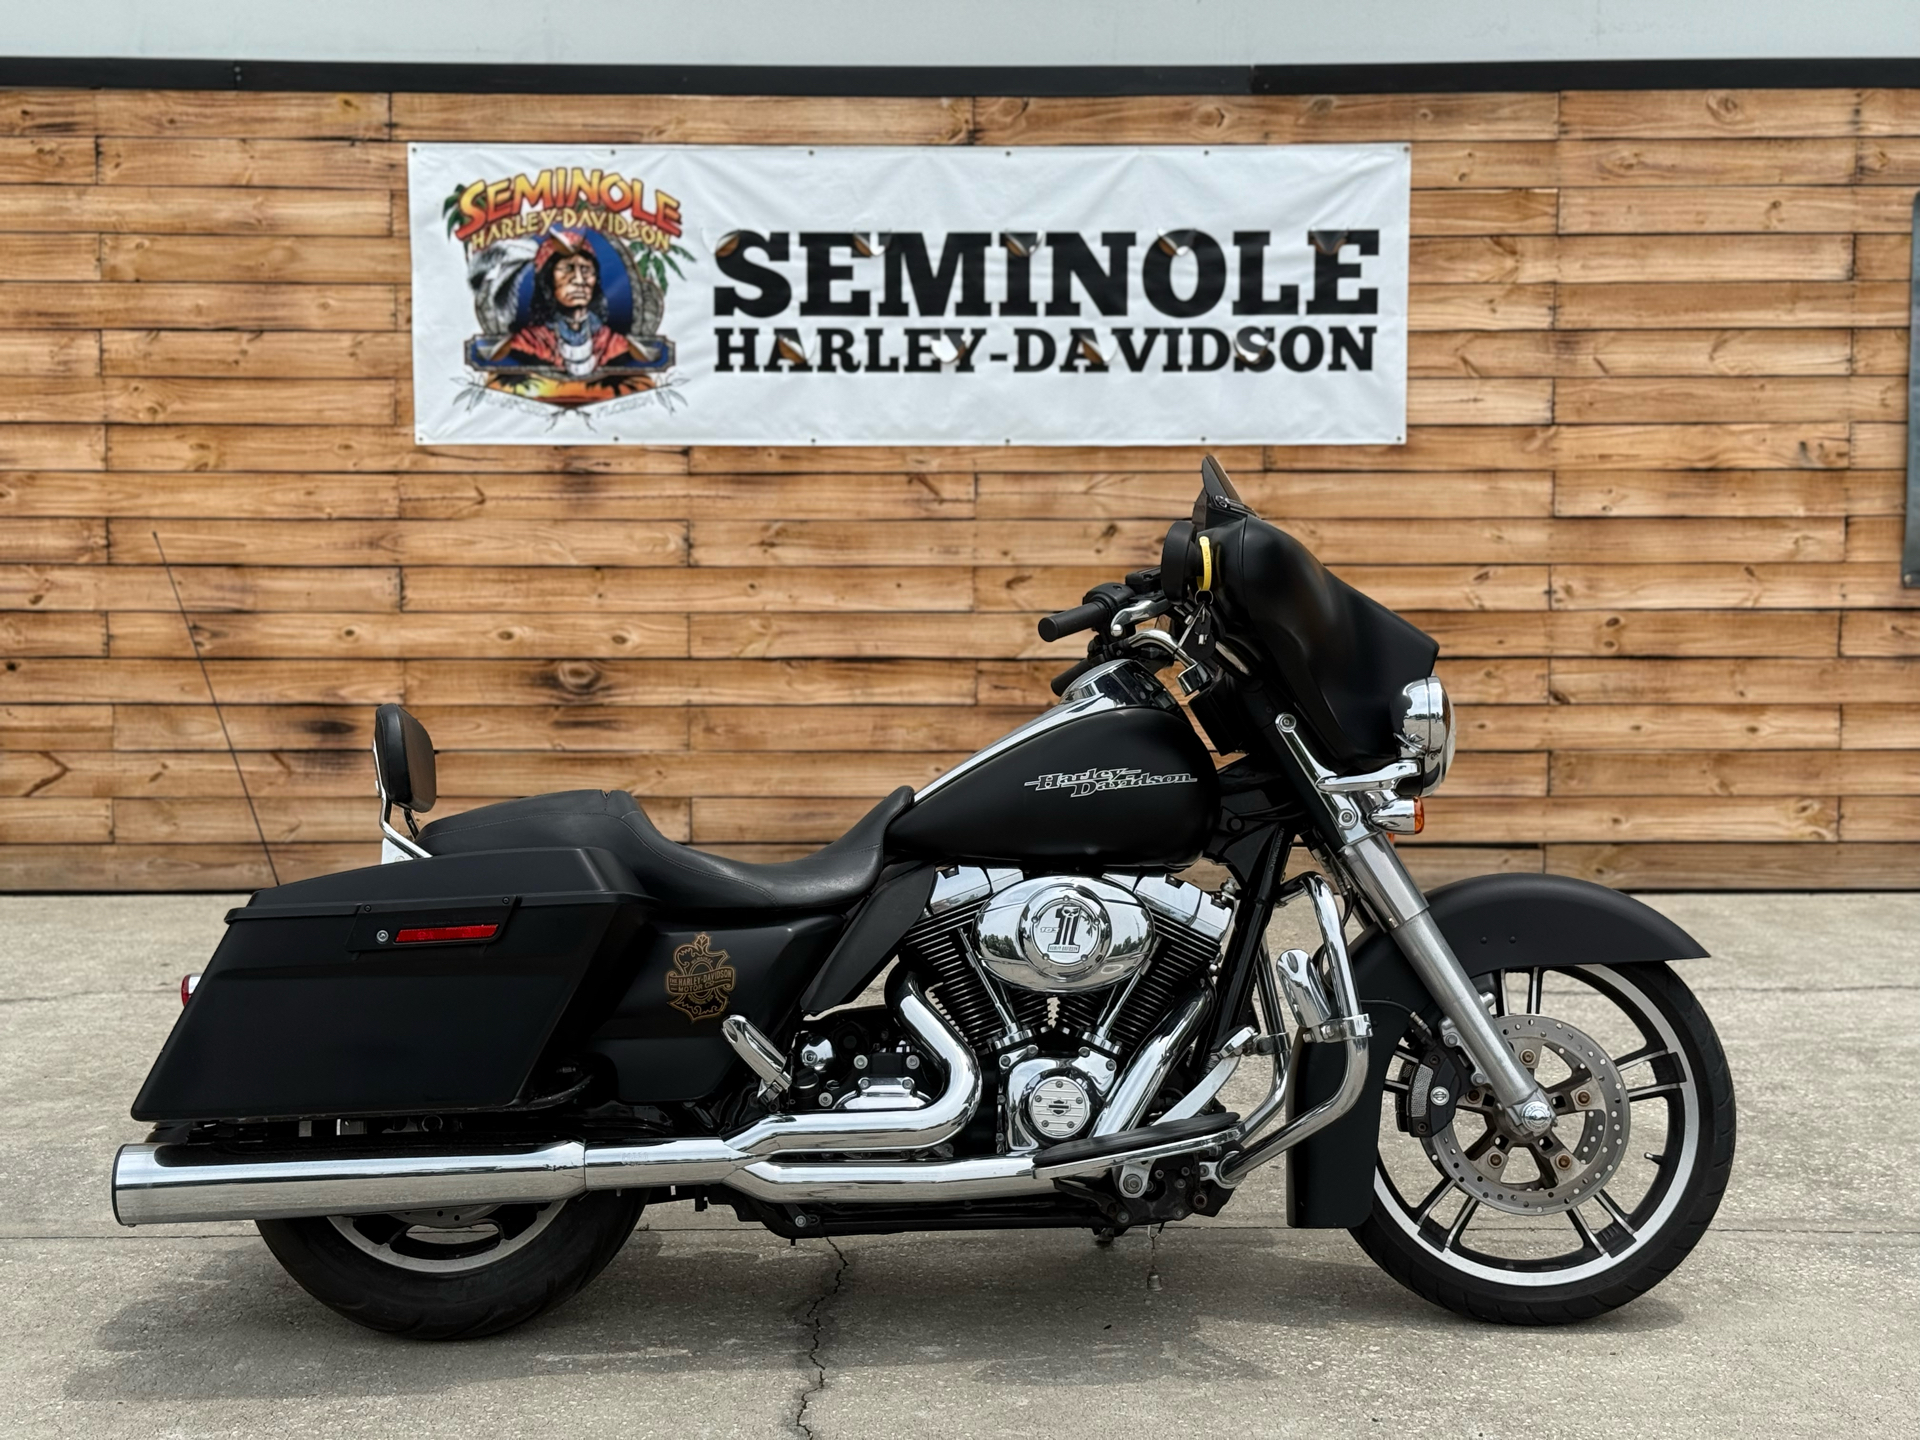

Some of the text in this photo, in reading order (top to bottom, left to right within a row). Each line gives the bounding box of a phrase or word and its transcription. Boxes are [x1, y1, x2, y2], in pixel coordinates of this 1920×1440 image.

[455, 167, 682, 240] SEMINOLE
[471, 207, 672, 251] HARLEY-DAVIDSON
[713, 228, 1380, 318] SEMINOLE
[713, 325, 1378, 373] HARLEY-DAVIDSON
[1024, 767, 1142, 791] Harley
[1061, 772, 1198, 798] Davidson
[678, 970, 731, 986] HARLEY-DAVIDSON
[678, 983, 704, 993] MOTOR
